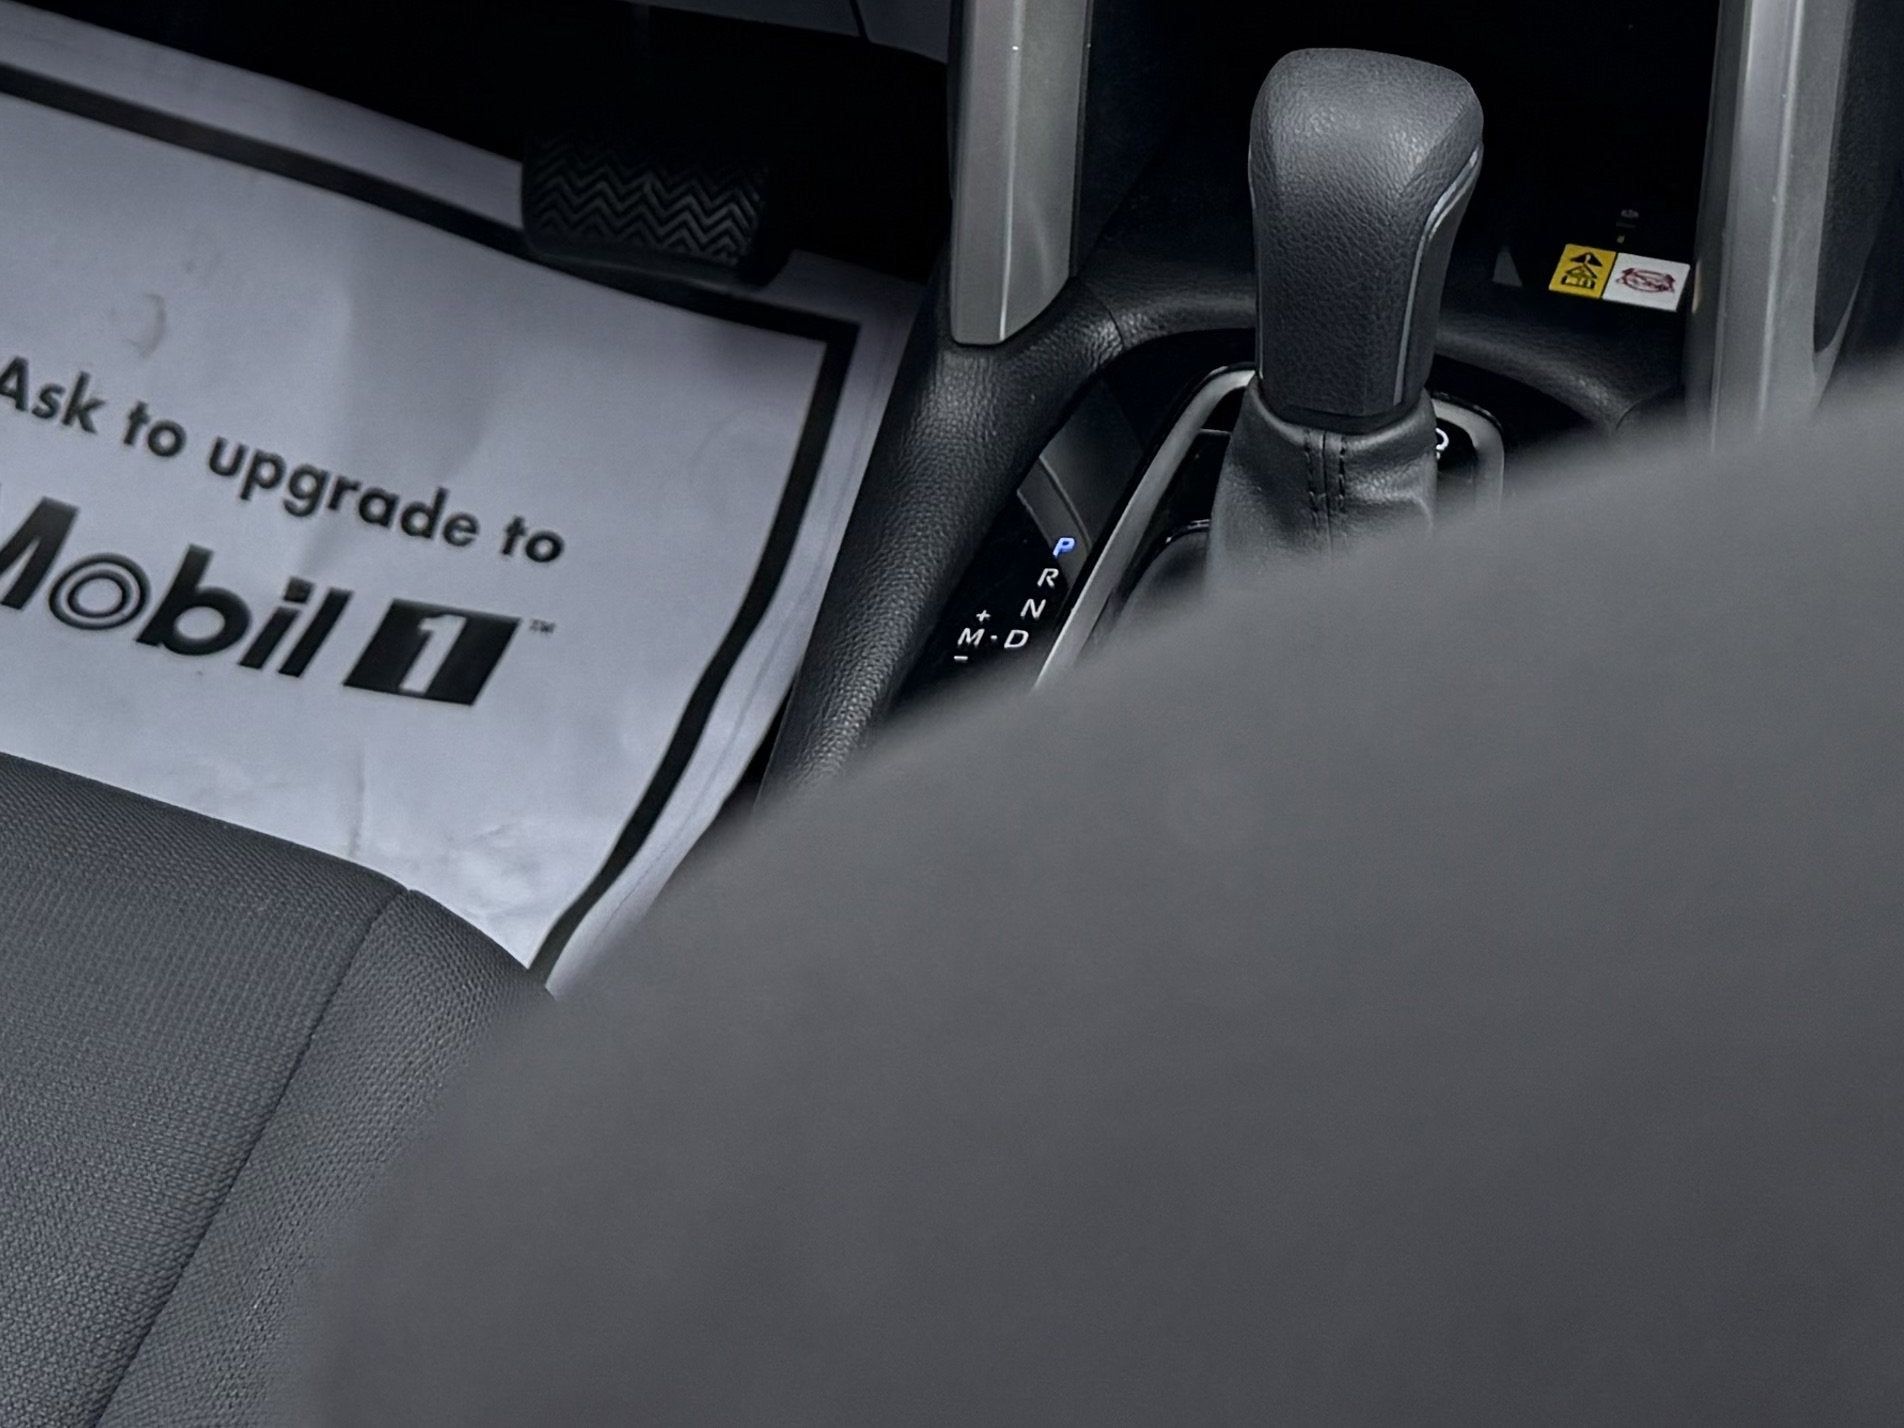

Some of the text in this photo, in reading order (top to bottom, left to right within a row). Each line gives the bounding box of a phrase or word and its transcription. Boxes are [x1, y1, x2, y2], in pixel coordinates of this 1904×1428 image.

[123, 400, 187, 460] to
[206, 435, 481, 549] upgrade
[500, 514, 566, 565] to
[1052, 536, 1076, 558] P
[1037, 567, 1059, 588] R
[1019, 597, 1047, 619] N
[957, 626, 1030, 649] M D
